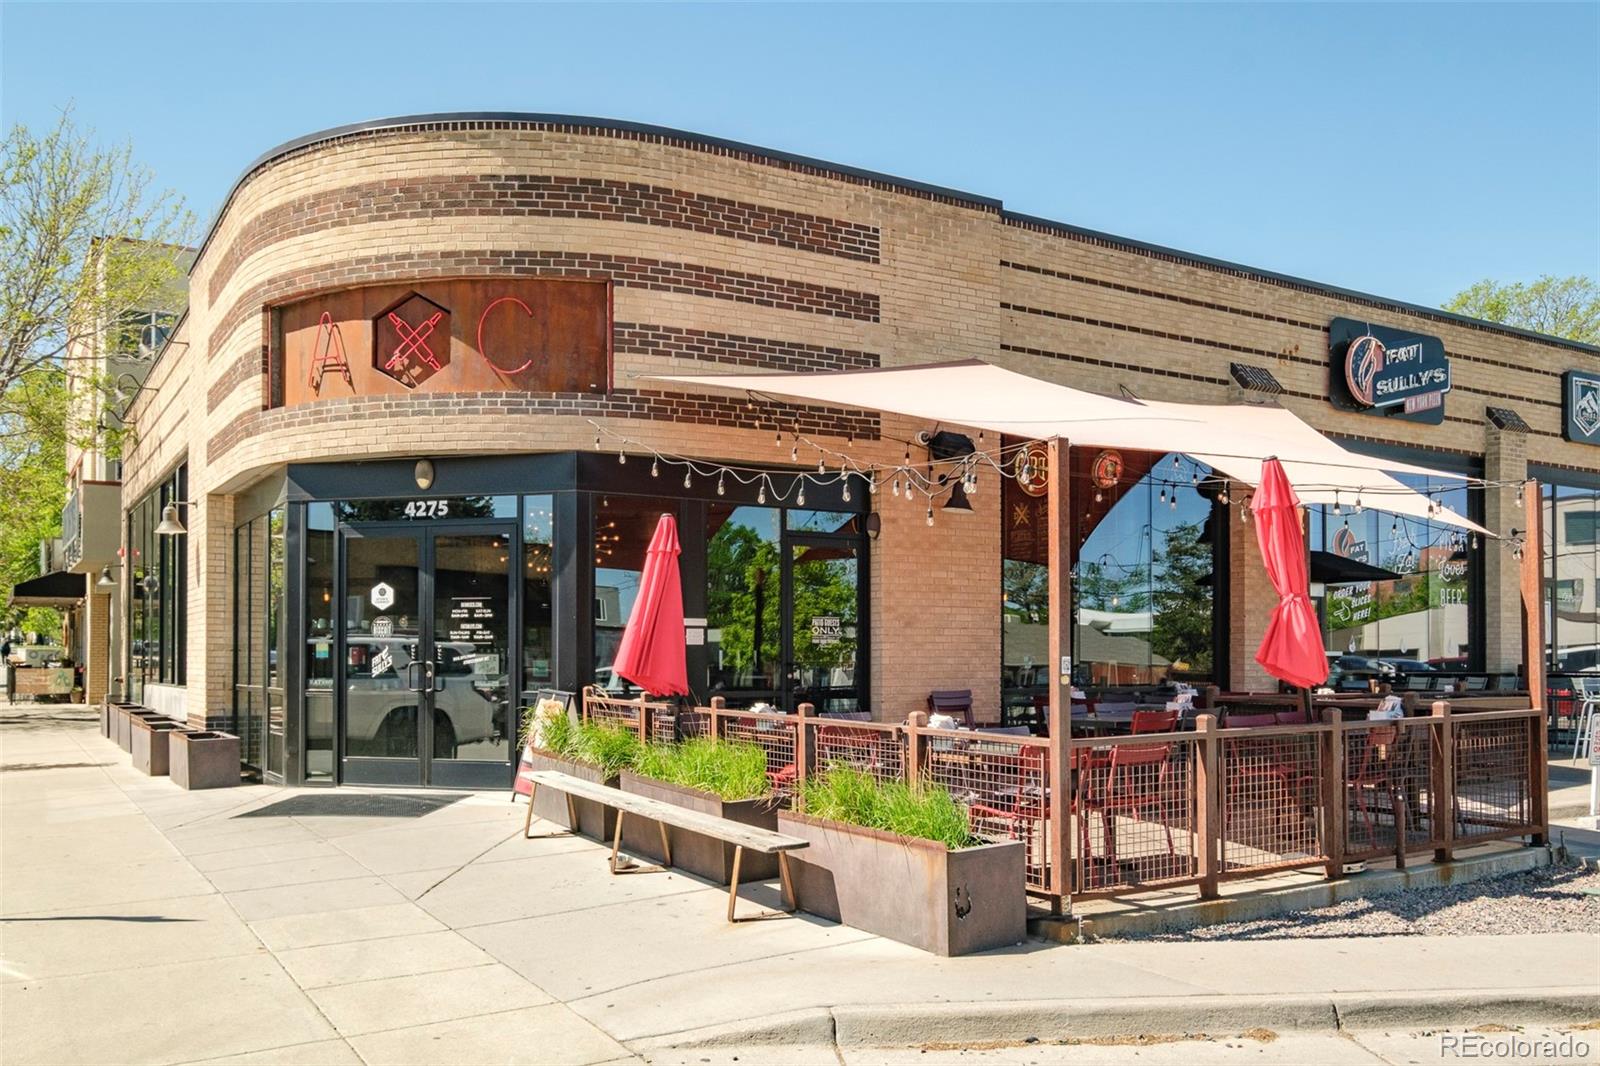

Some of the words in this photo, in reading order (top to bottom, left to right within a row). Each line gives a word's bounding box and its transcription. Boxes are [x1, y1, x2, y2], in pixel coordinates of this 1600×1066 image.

[1385, 344, 1420, 365] FAT
[1376, 367, 1447, 395] SULLY'S
[404, 500, 449, 517] 4275
[1350, 543, 1365, 554] FAT
[1438, 557, 1465, 582] Loves
[1333, 585, 1354, 600] ORDER
[1351, 593, 1371, 608] SLICES
[1440, 588, 1463, 607] BEER
[1352, 606, 1371, 621] HERE!
[811, 626, 840, 635] ONLY
